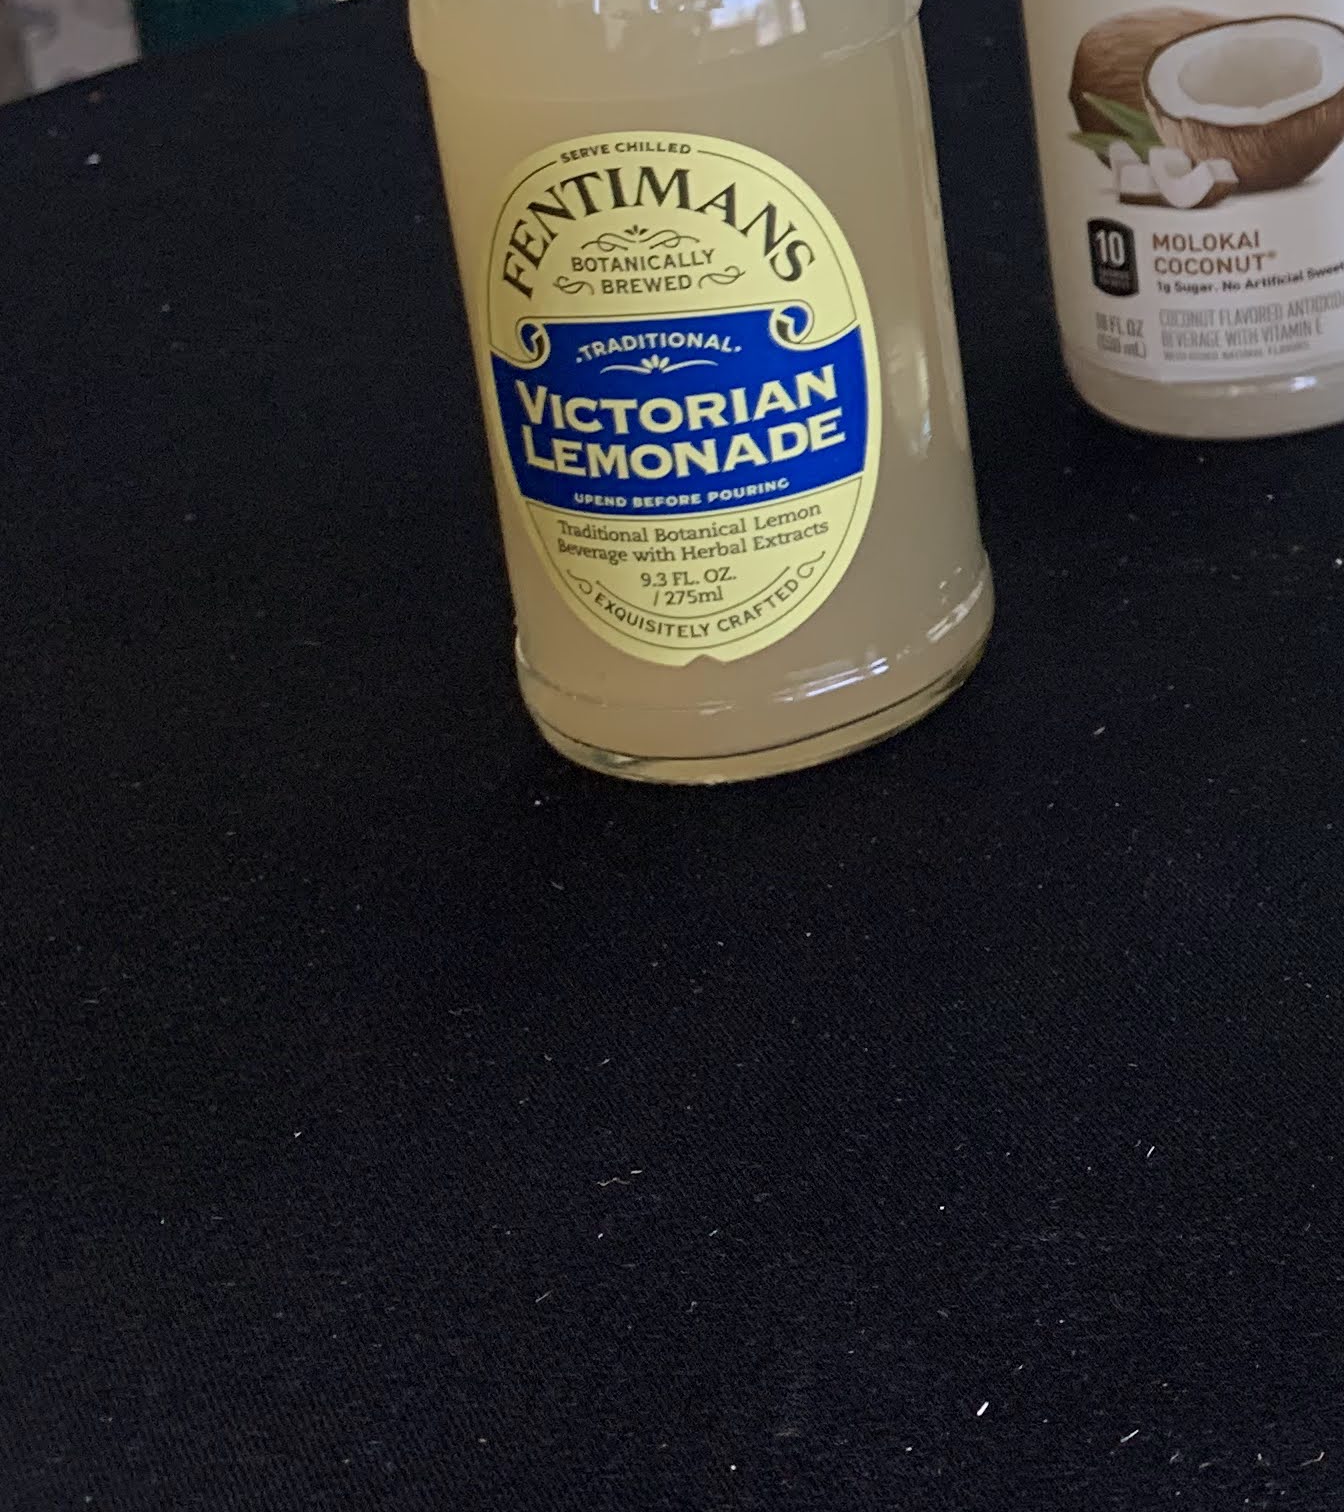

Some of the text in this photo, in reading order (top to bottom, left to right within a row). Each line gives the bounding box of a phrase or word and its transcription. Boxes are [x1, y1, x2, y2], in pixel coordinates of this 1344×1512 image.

[560, 141, 692, 164] SERVE CHILLED
[503, 166, 815, 298] FENTIMANS
[1152, 231, 1260, 252] MOLOKAI
[571, 248, 715, 272] BOTANICALLY
[1096, 229, 1125, 267] 10
[601, 275, 692, 295] BREWED
[1223, 281, 1240, 291] No
[1245, 270, 1303, 289] Artificial
[1219, 303, 1283, 326] FLAVORED
[1161, 330, 1220, 348] BEVERAGE
[1225, 330, 1259, 346] WITH
[1261, 320, 1312, 342] VITAMIN
[515, 364, 838, 434] VICTORIAN
[522, 408, 846, 480] LEMONADE
[574, 478, 790, 508] UPEND BEFORE POURING
[558, 502, 822, 544] Traditional Botanical Lemon
[557, 519, 829, 564] Beverage with Herbal Extracts
[640, 567, 737, 587] 9.3 FL. OZ.
[594, 577, 800, 638] EXQUISITELY CRAFTED
[665, 586, 724, 606] 275ml
